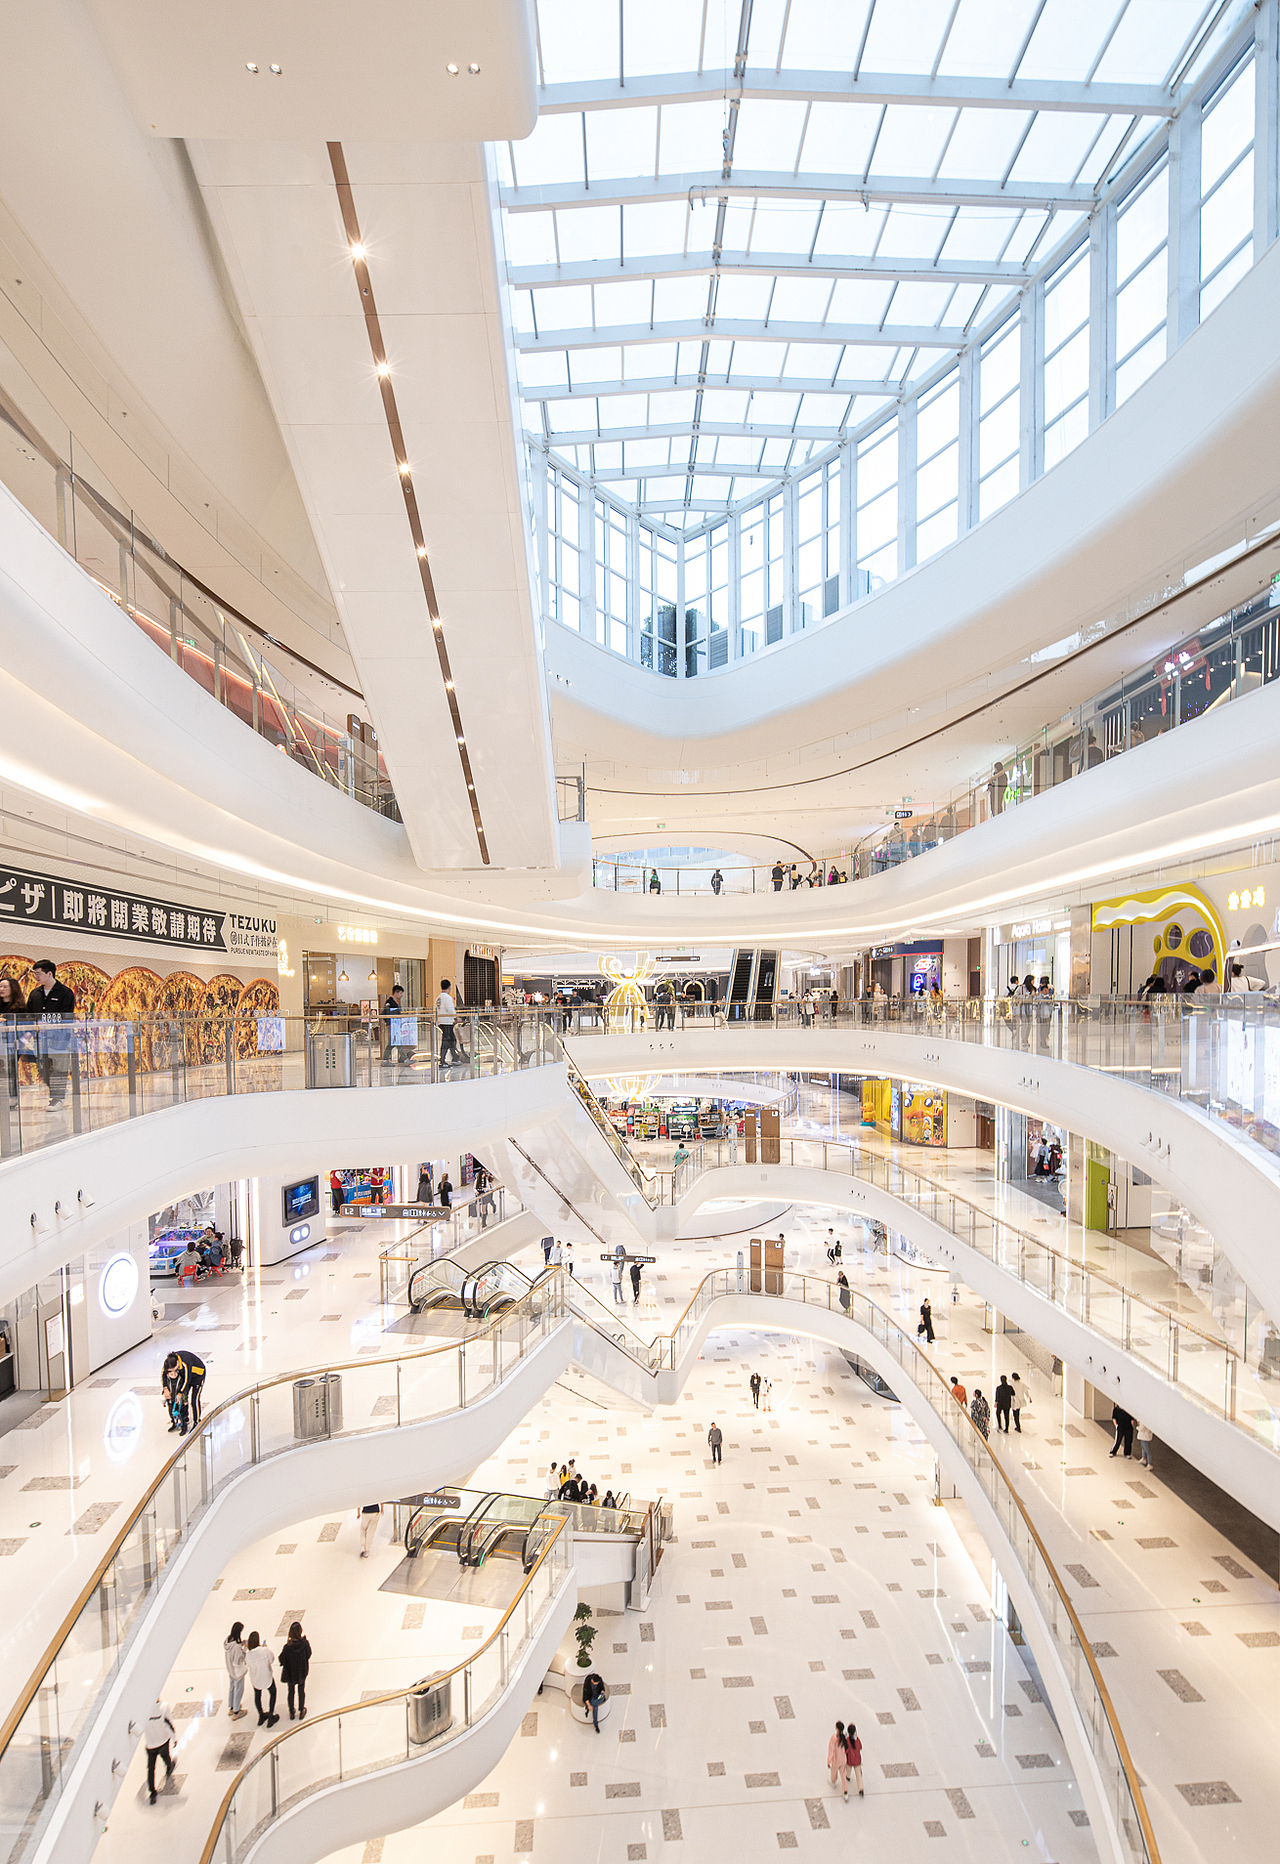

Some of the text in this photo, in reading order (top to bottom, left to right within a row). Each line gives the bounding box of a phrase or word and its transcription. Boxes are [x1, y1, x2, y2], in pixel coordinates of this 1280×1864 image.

[229, 914, 276, 933] TEZUKU
[1032, 919, 1052, 935] Home
[344, 1207, 354, 1215] L2
